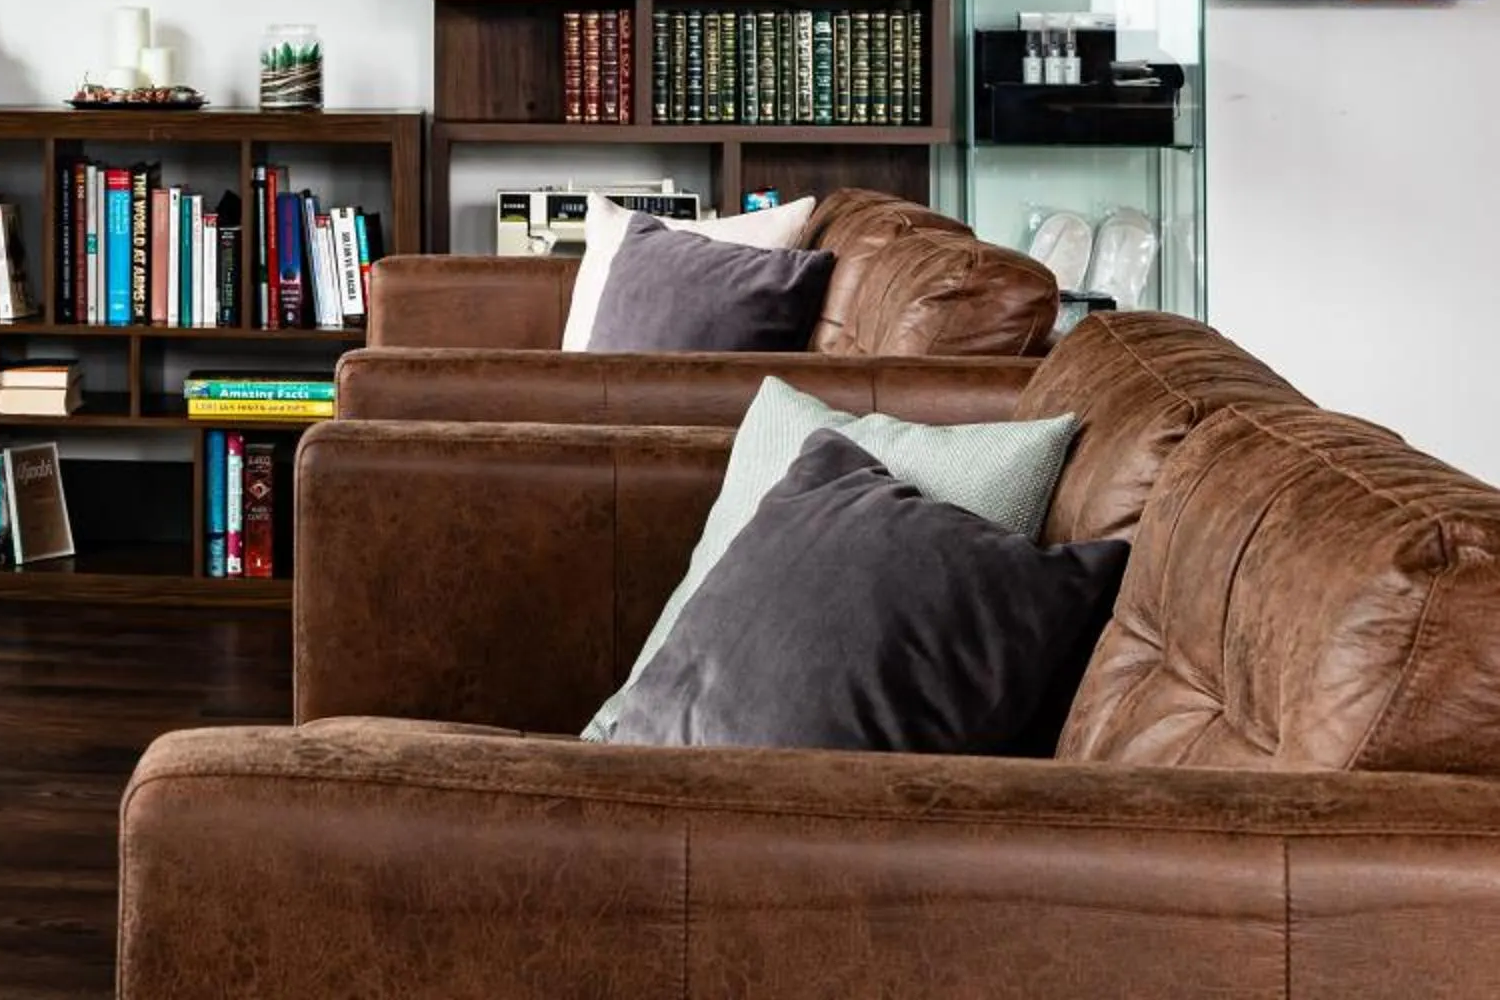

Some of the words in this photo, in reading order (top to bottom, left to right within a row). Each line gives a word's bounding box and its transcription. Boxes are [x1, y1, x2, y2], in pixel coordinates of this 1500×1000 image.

[133, 173, 147, 198] THE
[133, 200, 147, 246] WORLD
[133, 249, 147, 263] AT
[132, 265, 146, 305] ARMS
[219, 389, 273, 400] Amazing
[277, 388, 309, 399] Facts
